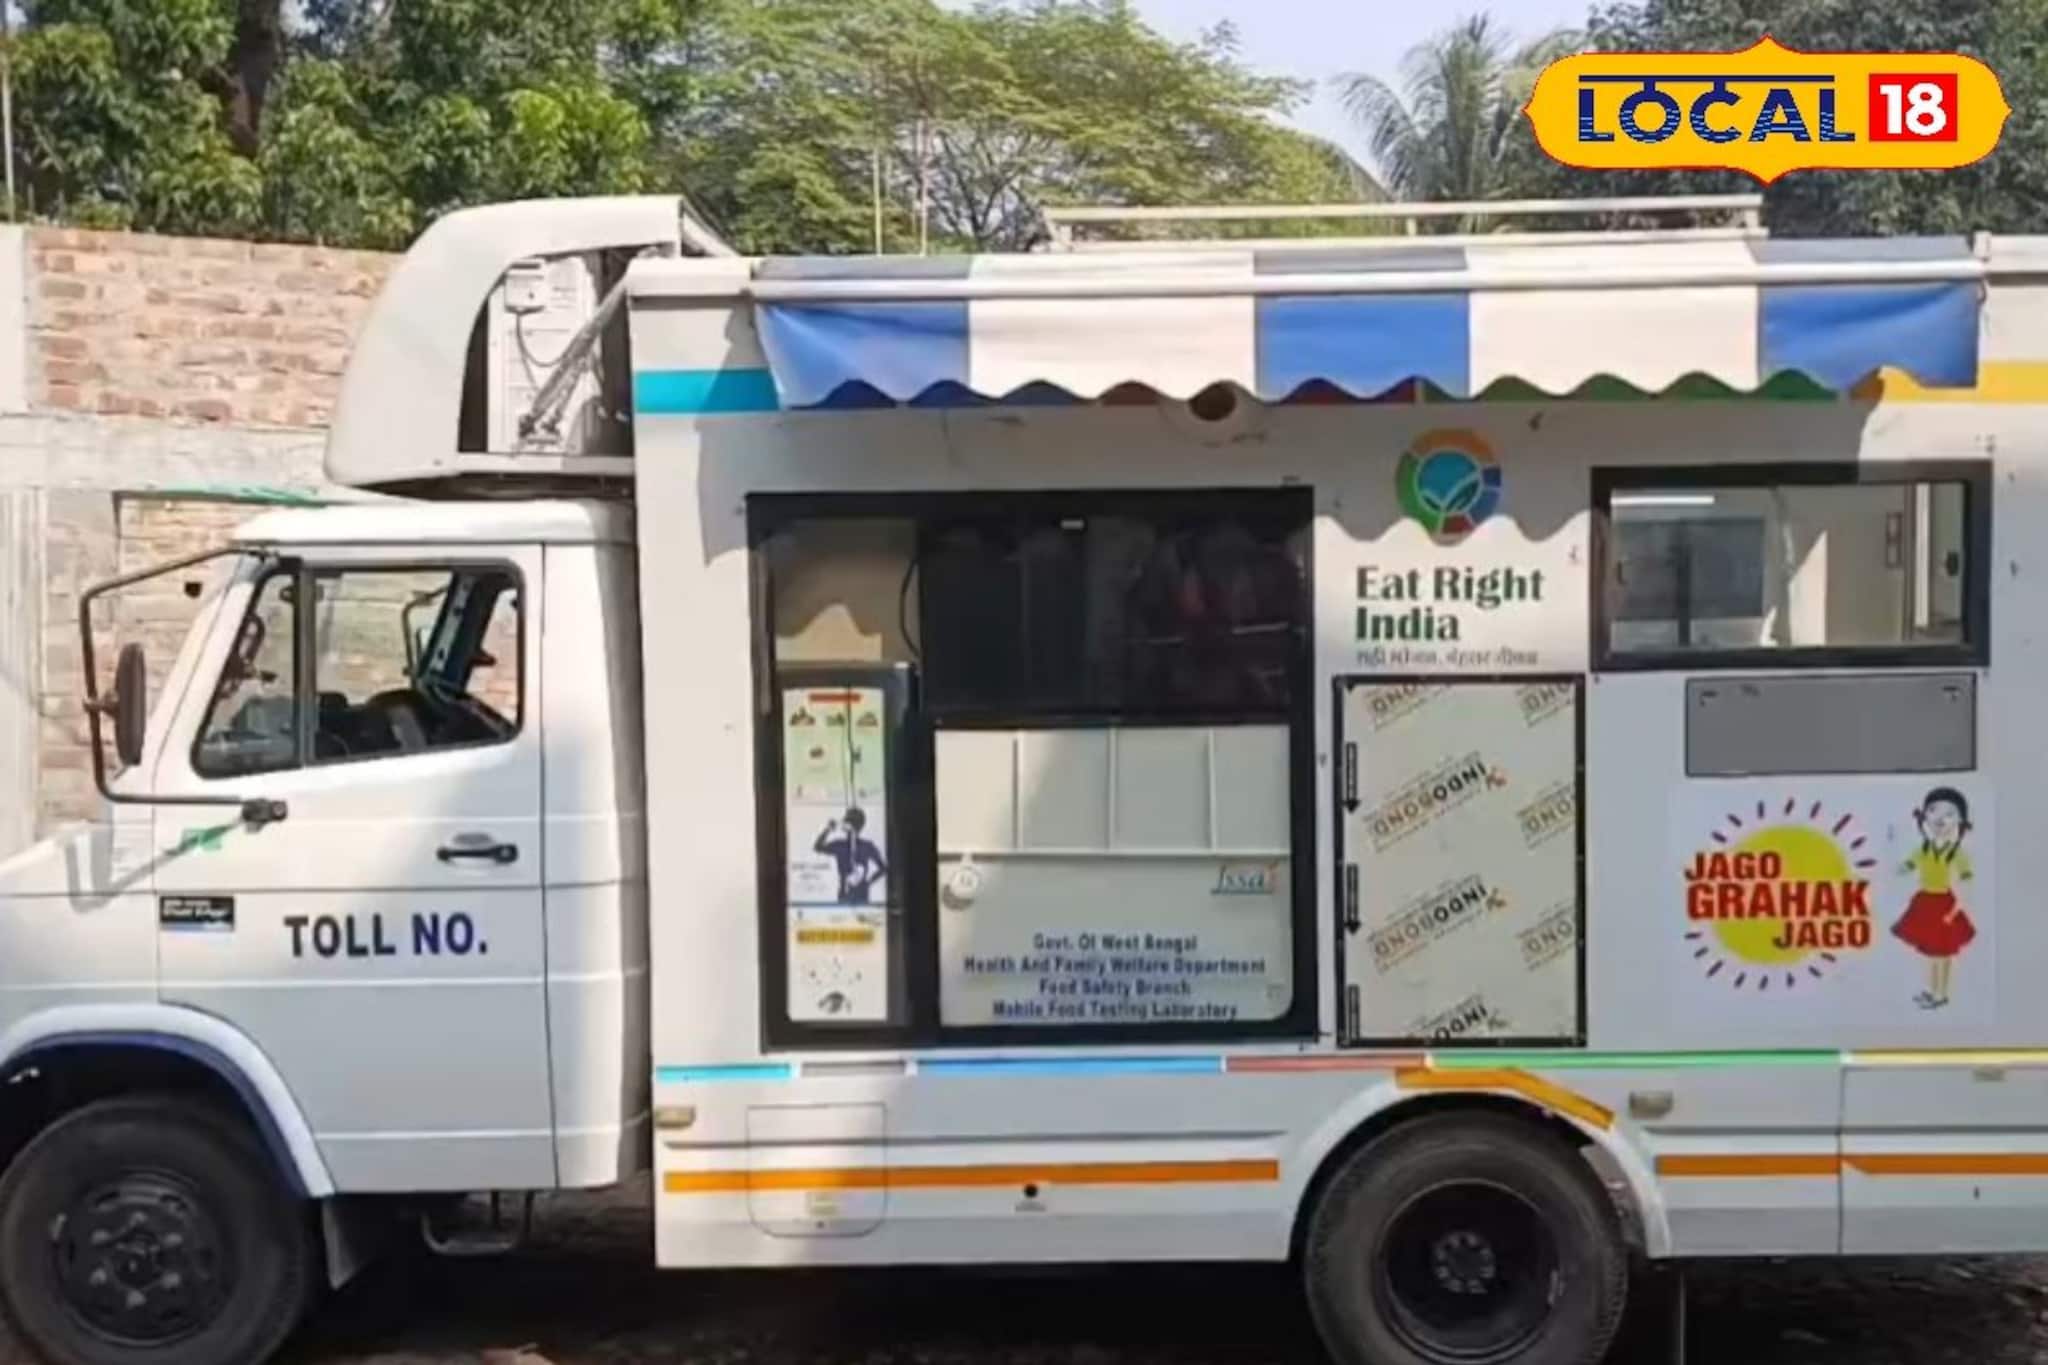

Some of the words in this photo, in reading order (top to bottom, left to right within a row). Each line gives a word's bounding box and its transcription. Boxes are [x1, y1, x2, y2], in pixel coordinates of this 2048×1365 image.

[1356, 565, 1420, 601] Eat
[1433, 565, 1545, 610] Right
[1356, 606, 1460, 641] India
[1684, 851, 1782, 881] JAGO
[1686, 881, 1870, 920] GRAHAK
[284, 914, 396, 957] TOLL
[412, 912, 488, 955] NO.
[1033, 933, 1073, 951] Govt.
[1102, 933, 1139, 951] West
[1145, 933, 1198, 956] Bengal
[1772, 919, 1871, 949] JAGO
[964, 956, 1016, 974] Health
[1021, 956, 1049, 974] And
[1055, 956, 1104, 977] Family
[1109, 956, 1170, 974] Welfare
[1174, 956, 1266, 977] Department
[1039, 978, 1077, 995] Food
[1081, 978, 1130, 998] Safety
[1135, 978, 1192, 995] Branch
[993, 1001, 1043, 1018] Mobile
[1049, 1001, 1086, 1018] Food
[1091, 1001, 1147, 1020] Testing
